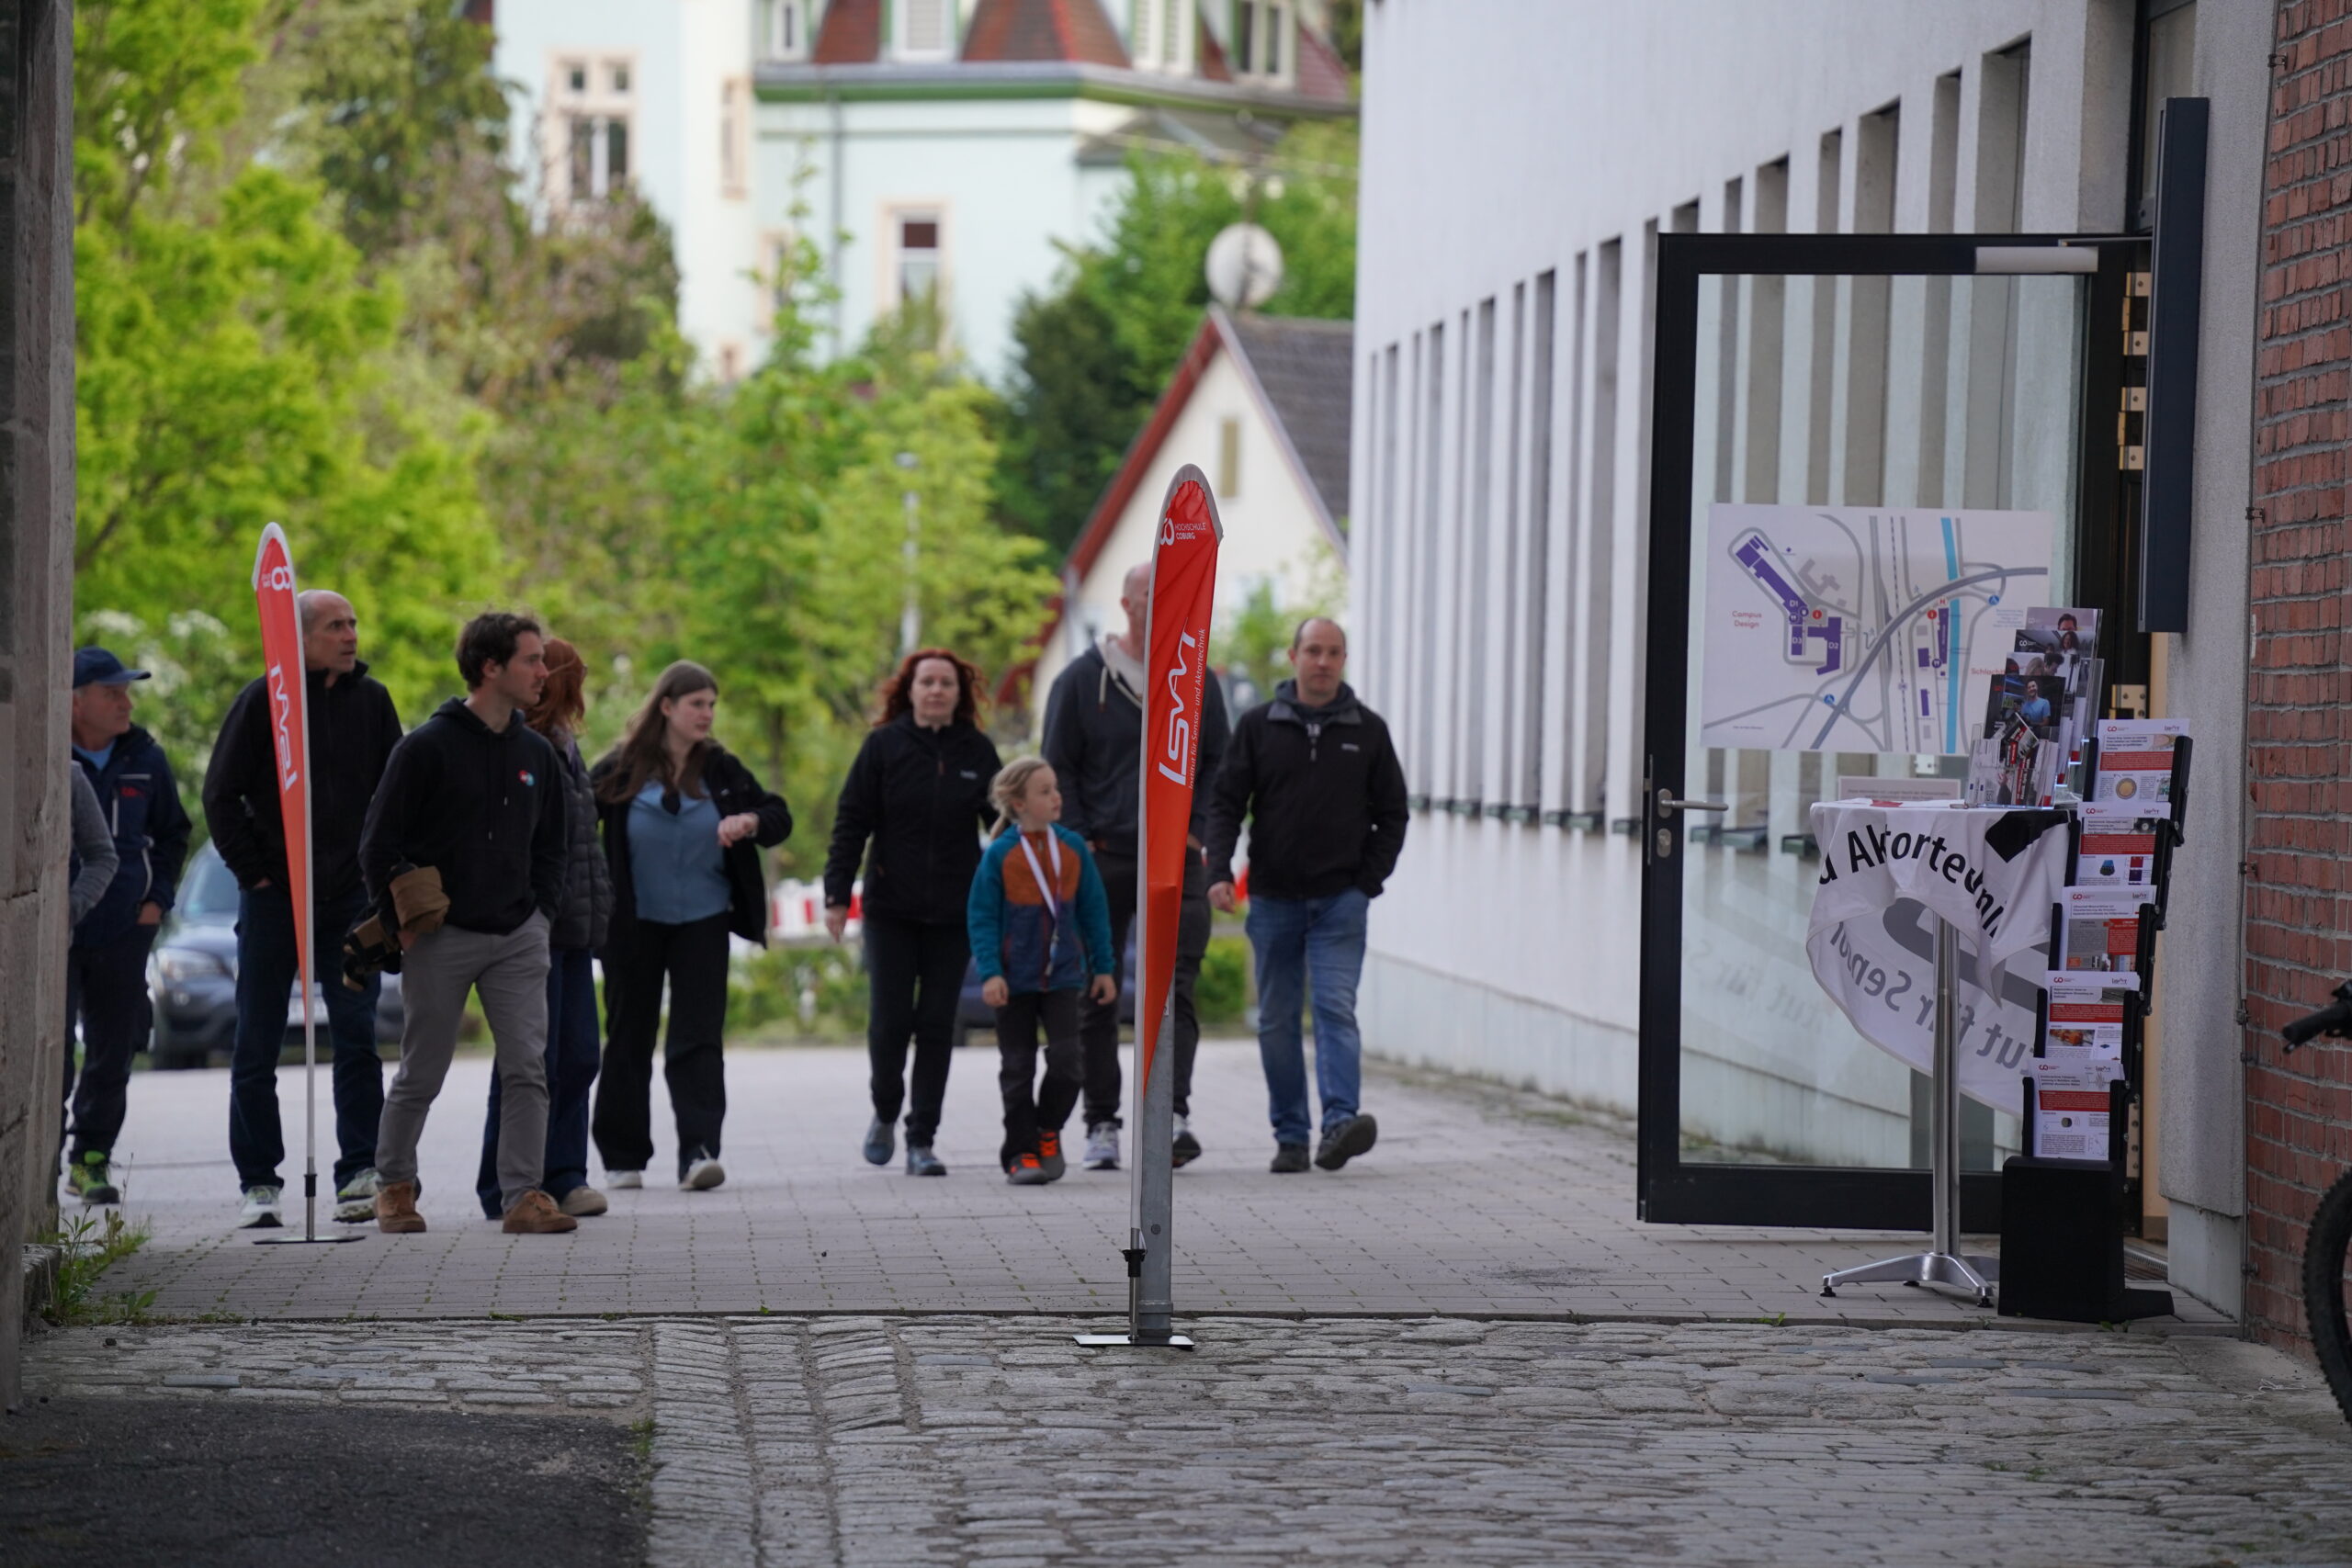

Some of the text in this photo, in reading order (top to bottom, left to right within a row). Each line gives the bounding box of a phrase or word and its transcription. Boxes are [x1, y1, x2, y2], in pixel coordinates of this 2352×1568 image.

[1175, 523, 1206, 531] HOCHSCHULE
[1176, 532, 1196, 540] COBURG
[1732, 610, 1762, 619] Campus
[1734, 620, 1760, 630] Design
[1189, 759, 1197, 790] Institut
[1195, 628, 1205, 687] Aktortechnik
